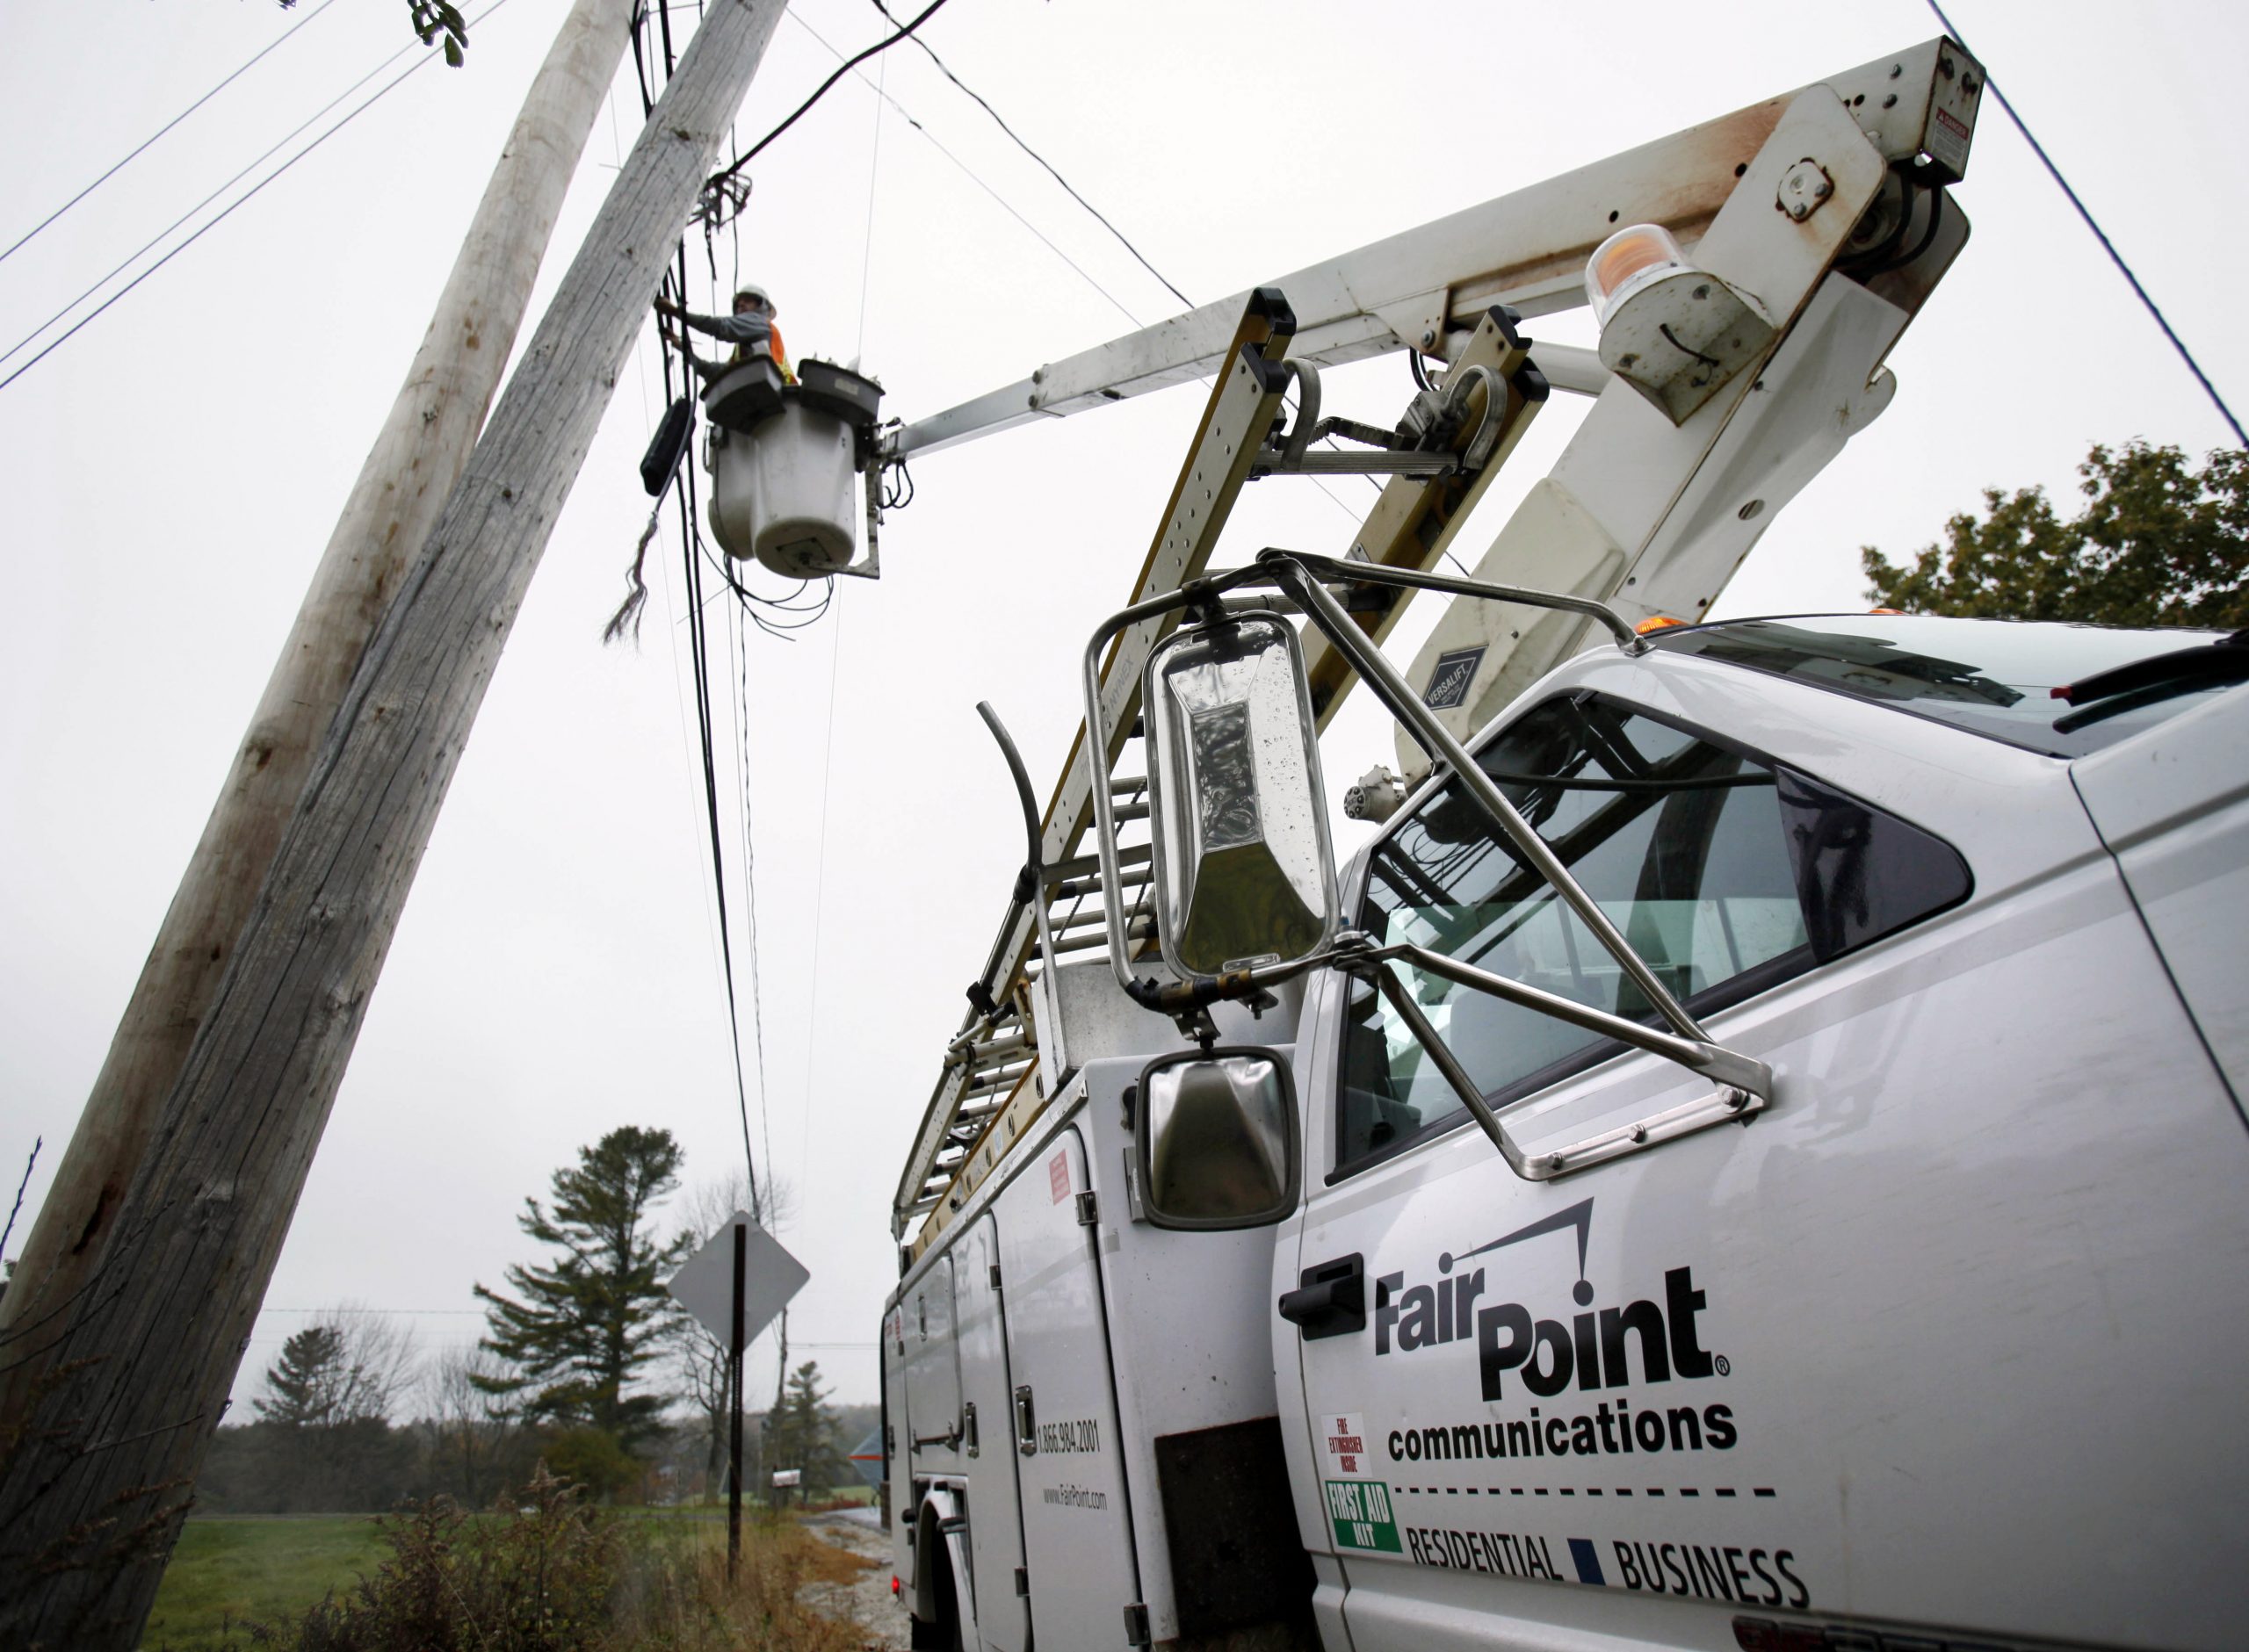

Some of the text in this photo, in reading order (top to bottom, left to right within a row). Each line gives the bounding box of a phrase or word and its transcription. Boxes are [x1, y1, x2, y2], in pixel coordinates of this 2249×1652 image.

[1110, 653, 1133, 710] NYNEX
[1428, 663, 1466, 704] VERSALIFT
[1038, 1418, 1100, 1454] 1.866.984.2001
[1336, 1418, 1349, 1434] FIRE
[1388, 1399, 1737, 1461] communications
[1328, 1437, 1363, 1454] EXTINGUISHER
[1341, 1455, 1358, 1473] INSIDE
[1043, 1483, 1107, 1511] www.FairPoint.com
[1327, 1482, 1390, 1523] FIRST AID
[1353, 1522, 1376, 1547] KIT
[1406, 1527, 1810, 1609] RESIDENTIAL BUSINESS
